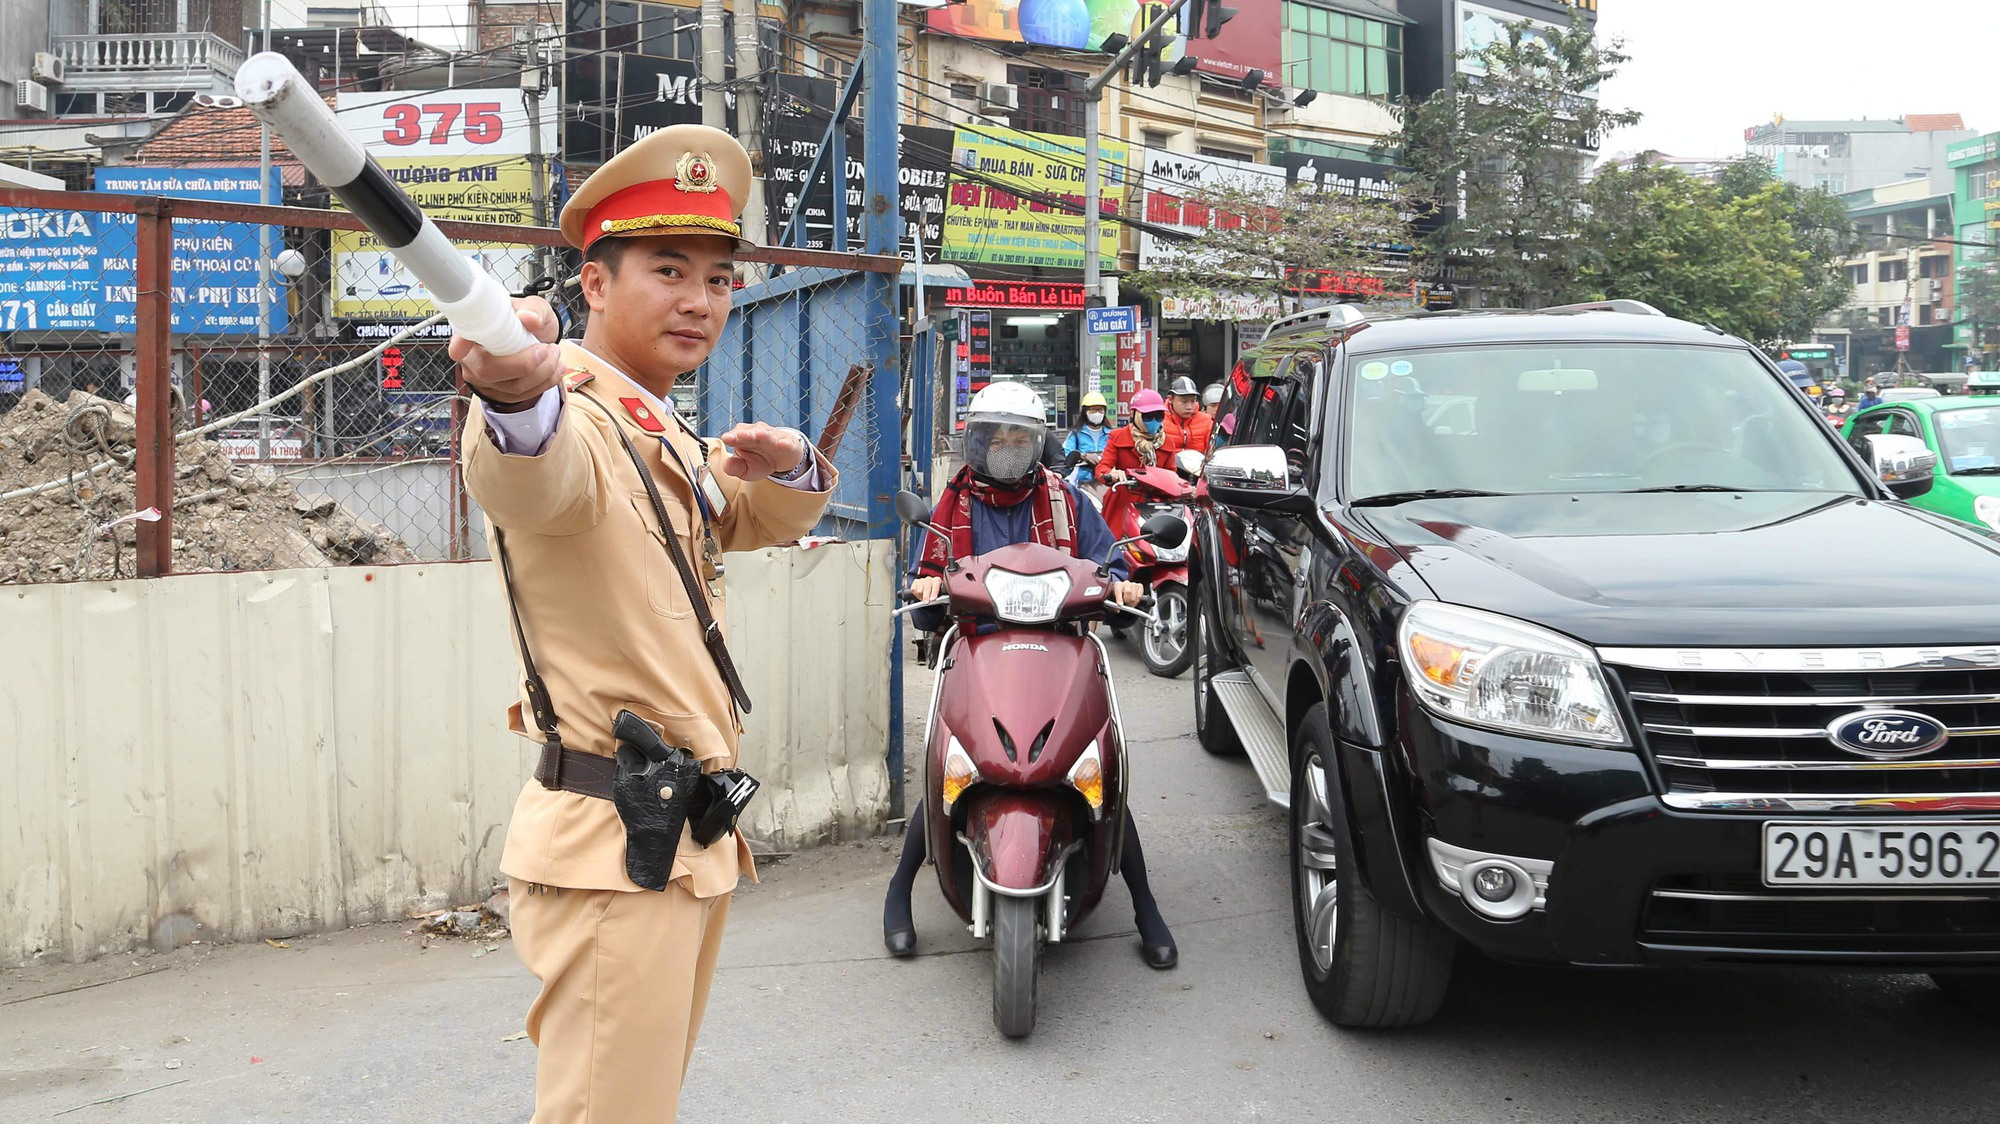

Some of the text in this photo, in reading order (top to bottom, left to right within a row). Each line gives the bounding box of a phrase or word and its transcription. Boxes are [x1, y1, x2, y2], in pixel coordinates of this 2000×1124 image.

[383, 102, 503, 146] 375
[1585, 129, 1600, 148] 18
[791, 141, 820, 158] ĐTD
[458, 166, 497, 182] ANH
[898, 167, 946, 188] OBILE
[980, 157, 1006, 173] MUA
[1010, 158, 1034, 177] BÁN
[1045, 163, 1067, 180] SỬA
[1152, 159, 1201, 182] Anh Tuấn
[105, 177, 262, 192] TRUNG TÂM SỬA CHỮA ĐIỆN THO
[426, 194, 445, 206] LINH
[490, 189, 517, 204] CHÍNH
[951, 182, 981, 211] ĐIỆN
[974, 215, 983, 228] ÉP
[1004, 220, 1018, 231] THAY
[1051, 225, 1085, 238] SMARTPHON
[1102, 229, 1118, 239] NGAY
[62, 247, 71, 256] DI
[72, 245, 98, 257] ĐỘNG
[174, 237, 233, 252] PHỤ KIỆN
[103, 258, 130, 271] MUA
[171, 257, 191, 273] IỆN
[194, 258, 231, 274] THOẠI
[25, 281, 66, 292] SAMSUNG
[966, 286, 1004, 304] Buôn
[1009, 286, 1036, 305] Bán
[1041, 287, 1057, 305] Lẻ
[198, 287, 232, 308] PHỤ
[0, 300, 37, 329] 71
[71, 299, 97, 317] GIẤY
[1102, 310, 1128, 318] ĐƯỜNG
[1093, 319, 1109, 332] CẦU
[1110, 317, 1127, 330] GIẤY
[1001, 643, 1049, 652] HONDA
[1858, 719, 1921, 744] Ford
[1774, 831, 2000, 879] 29A-596.2
